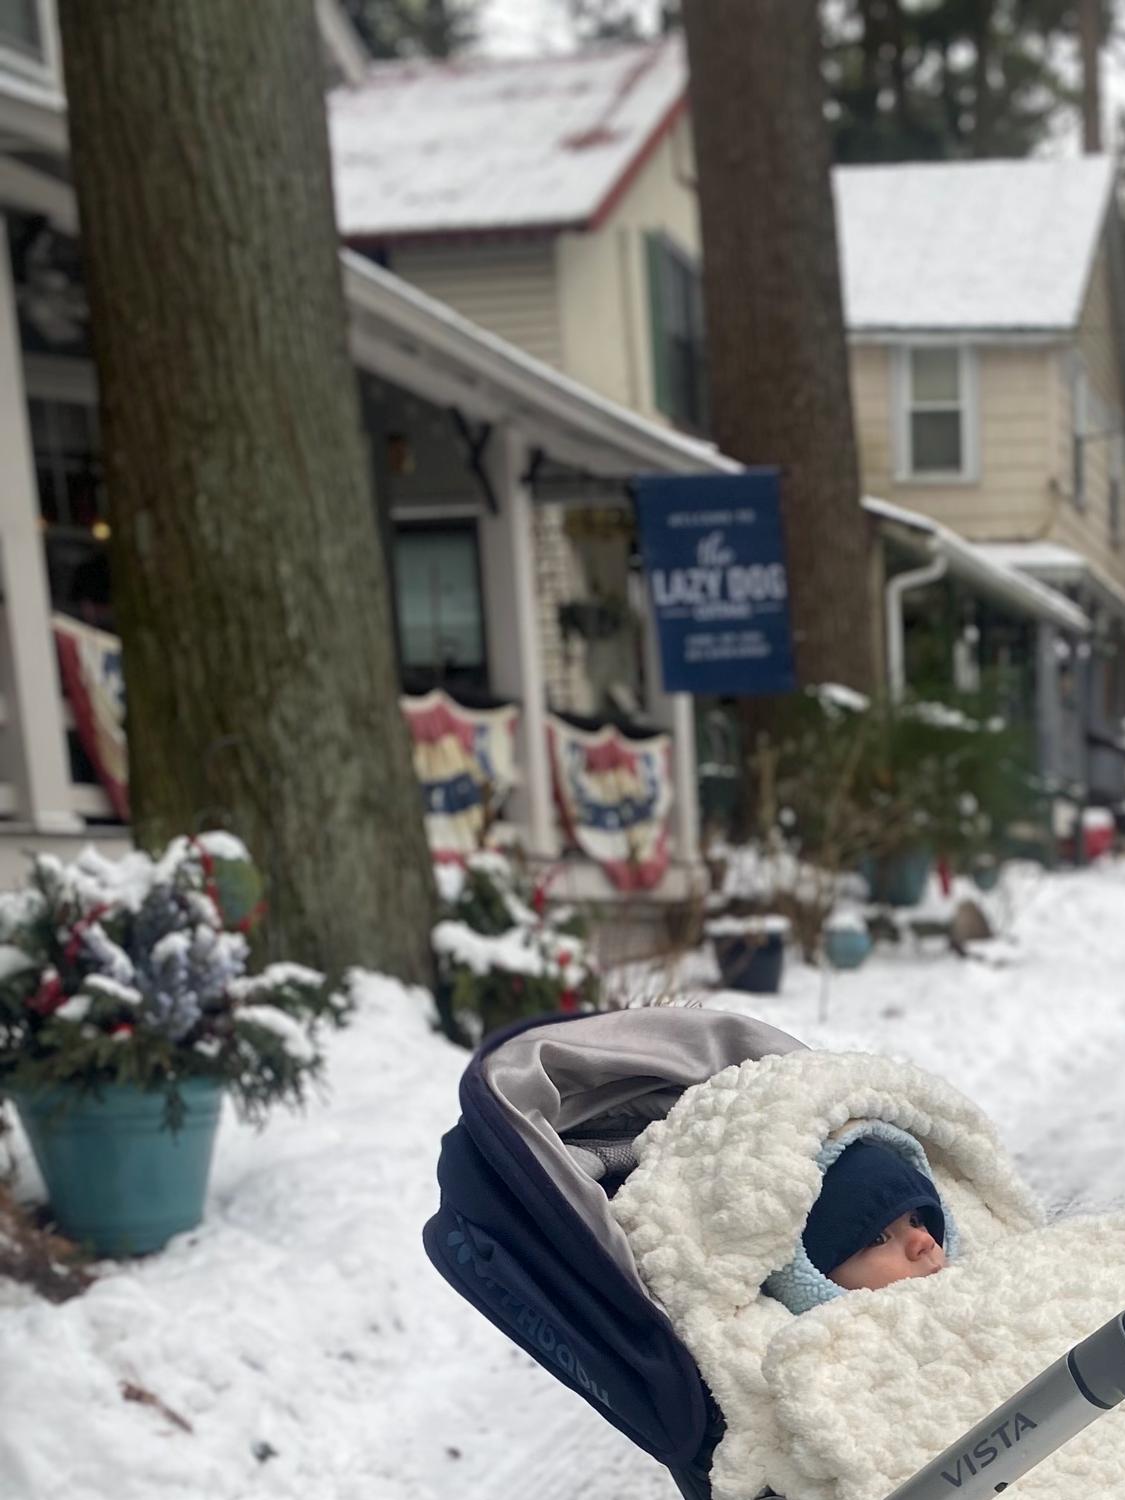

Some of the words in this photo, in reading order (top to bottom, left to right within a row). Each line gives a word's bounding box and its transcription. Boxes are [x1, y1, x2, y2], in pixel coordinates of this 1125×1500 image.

[652, 567, 722, 606] LAZY
[726, 562, 787, 602] DOG
[940, 1412, 1038, 1487] VISTA
